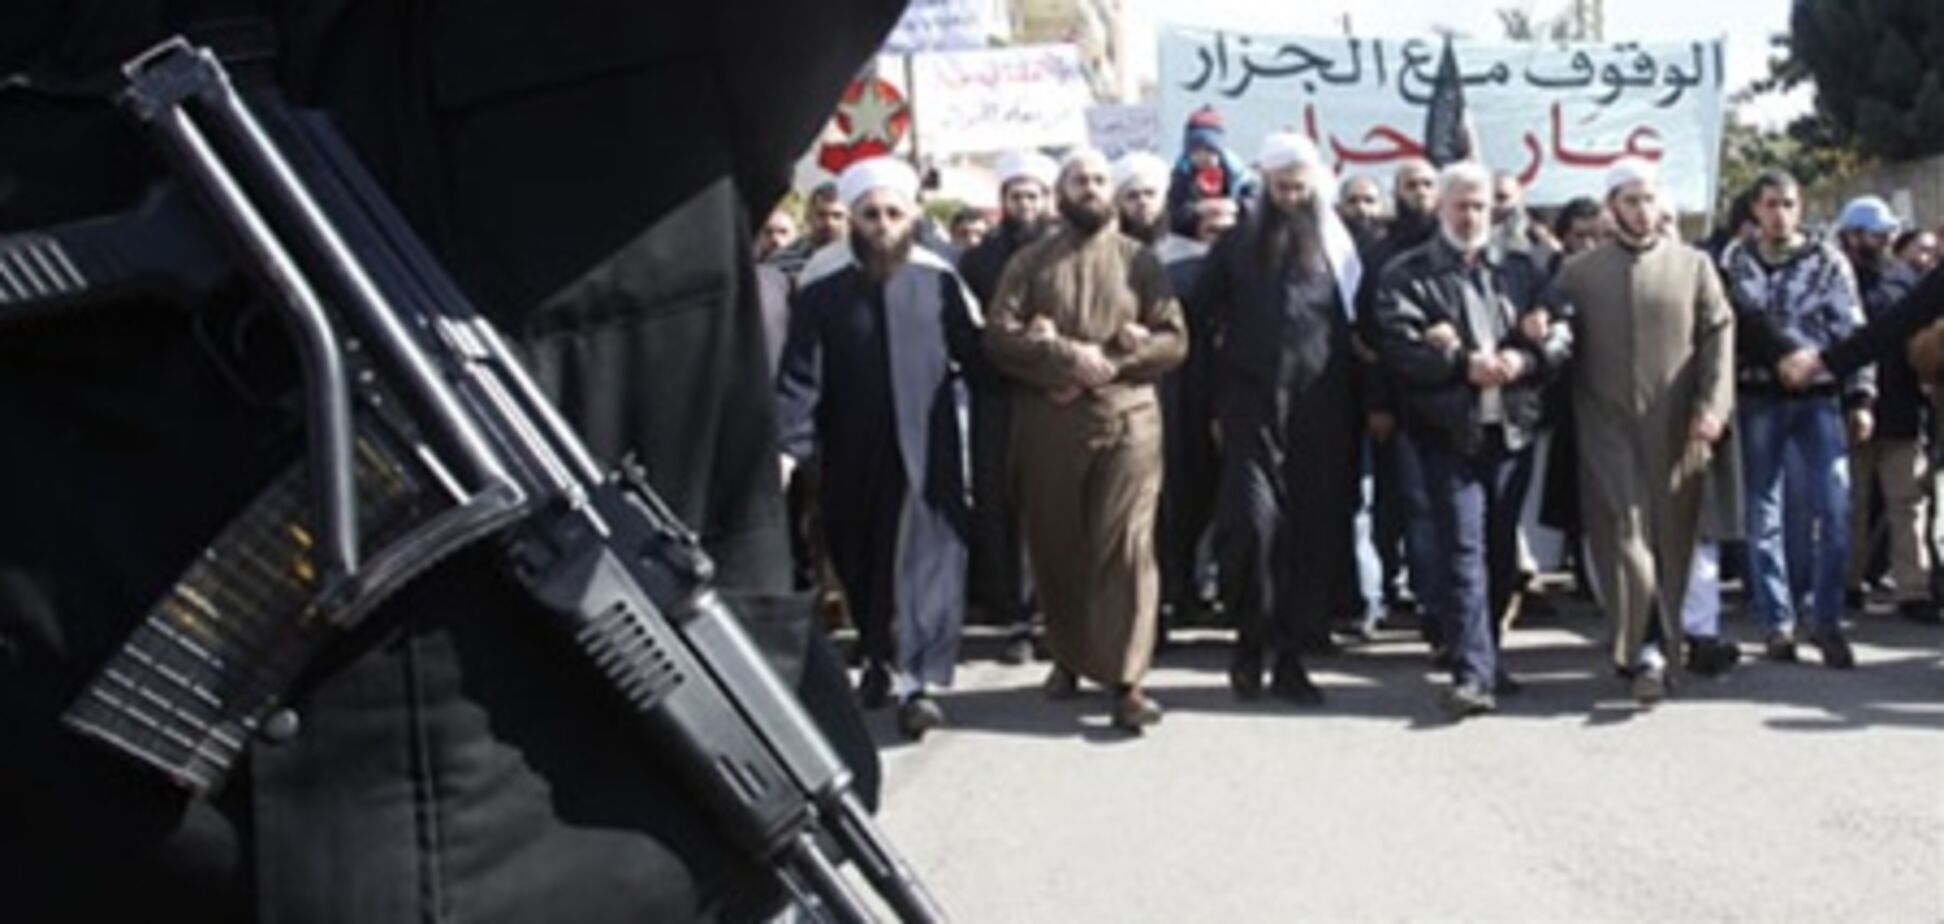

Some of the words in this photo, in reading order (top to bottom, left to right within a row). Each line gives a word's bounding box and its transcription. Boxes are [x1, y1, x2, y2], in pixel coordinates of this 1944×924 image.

[1176, 30, 1387, 98] الجزار
[1397, 38, 1510, 105] مع
[1524, 40, 1724, 107] الوقوف
[1516, 101, 1664, 186] عار
